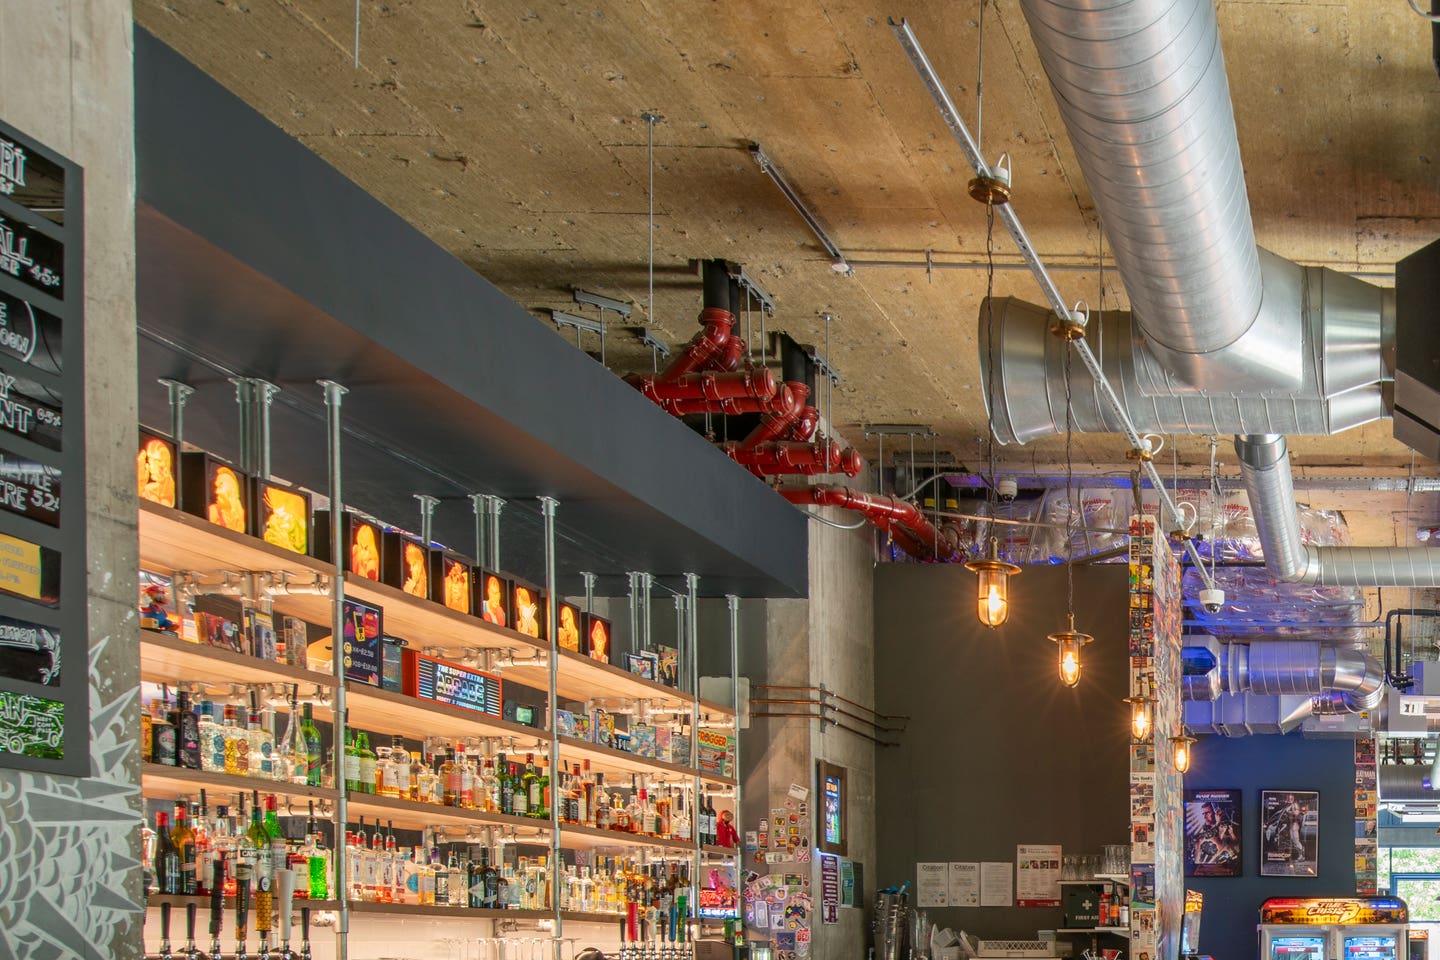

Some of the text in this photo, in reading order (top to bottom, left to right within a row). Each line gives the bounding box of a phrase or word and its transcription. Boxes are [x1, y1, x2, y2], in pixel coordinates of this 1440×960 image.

[1356, 770, 1375, 779] BATMAN
[1308, 906, 1346, 915] CRISIS
[1338, 902, 1361, 923] 3
